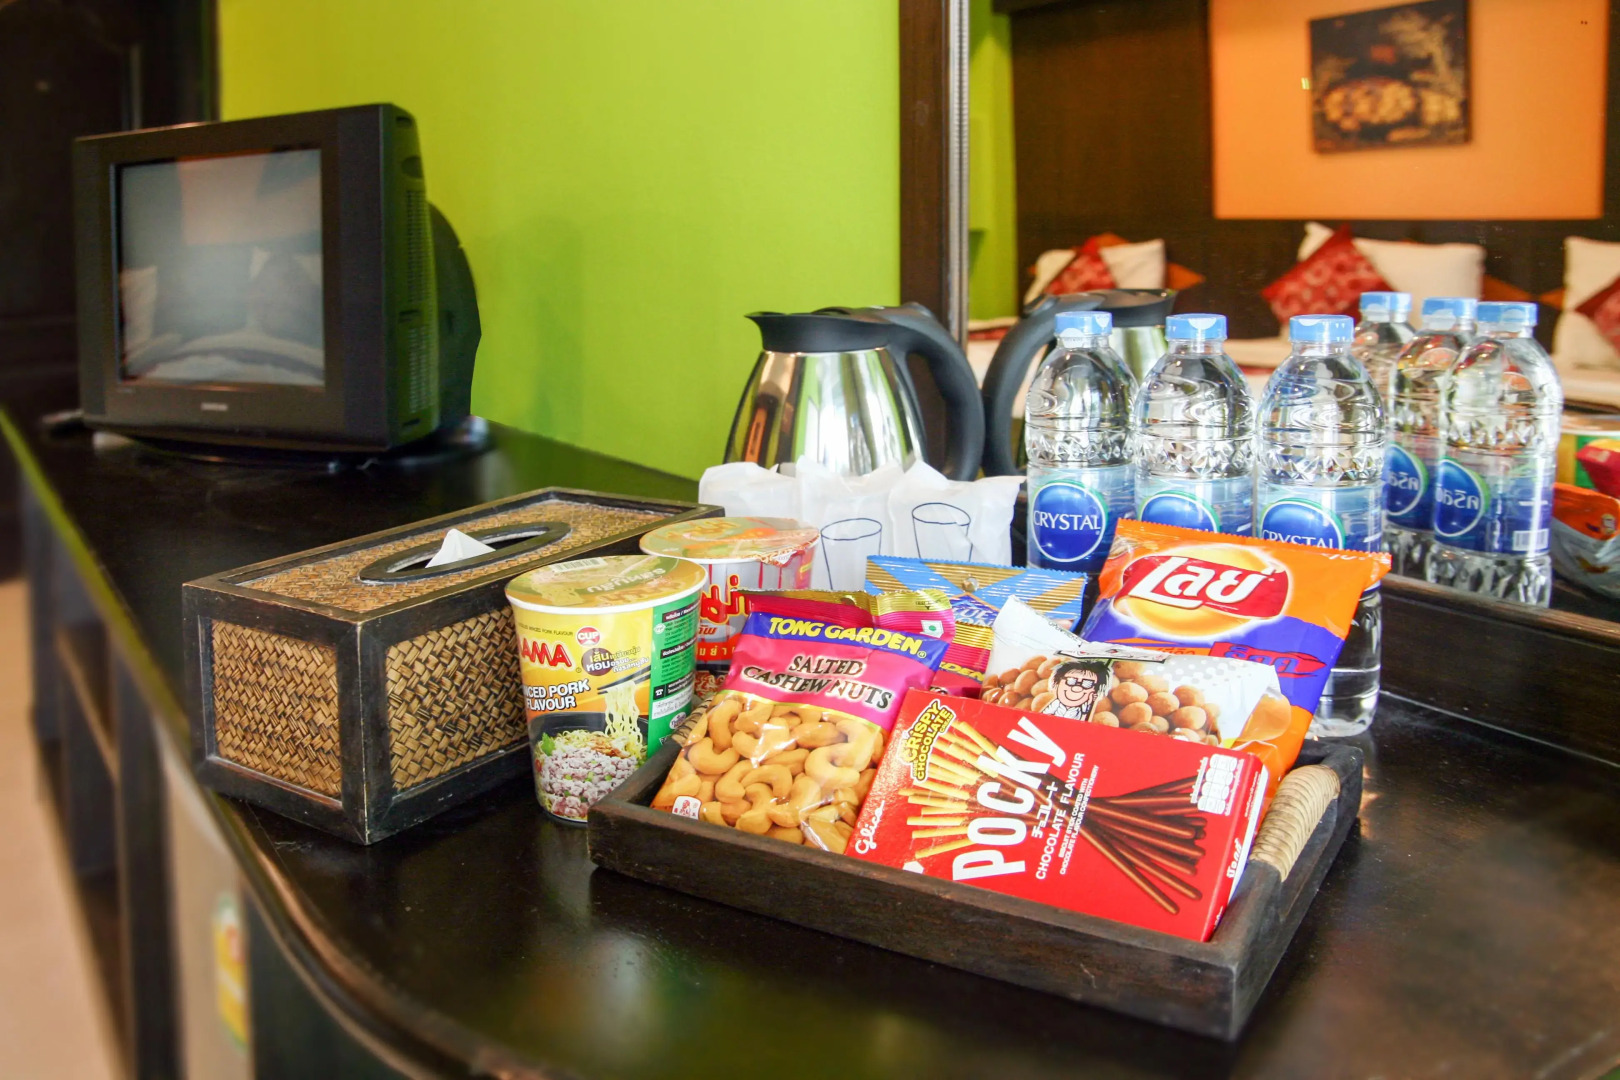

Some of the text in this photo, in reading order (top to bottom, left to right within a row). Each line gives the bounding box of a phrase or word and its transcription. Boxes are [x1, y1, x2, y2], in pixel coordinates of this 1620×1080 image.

[1033, 510, 1101, 531] CRYSTAL
[519, 637, 572, 668] AMA
[577, 631, 599, 641] CUP
[769, 617, 922, 656] TONG GARDEN
[788, 655, 864, 676] SALTED
[548, 678, 591, 698] PORK
[743, 666, 893, 710] CASHEW NUTS
[917, 708, 952, 780] CHOCOLATE
[1031, 781, 1059, 838] チョコレート
[1071, 793, 1084, 816] COATED
[1079, 778, 1088, 793] WITH
[1035, 752, 1085, 880] CHOCOLATE FLAVOUR
[1059, 839, 1077, 875] CHOCOLATE
